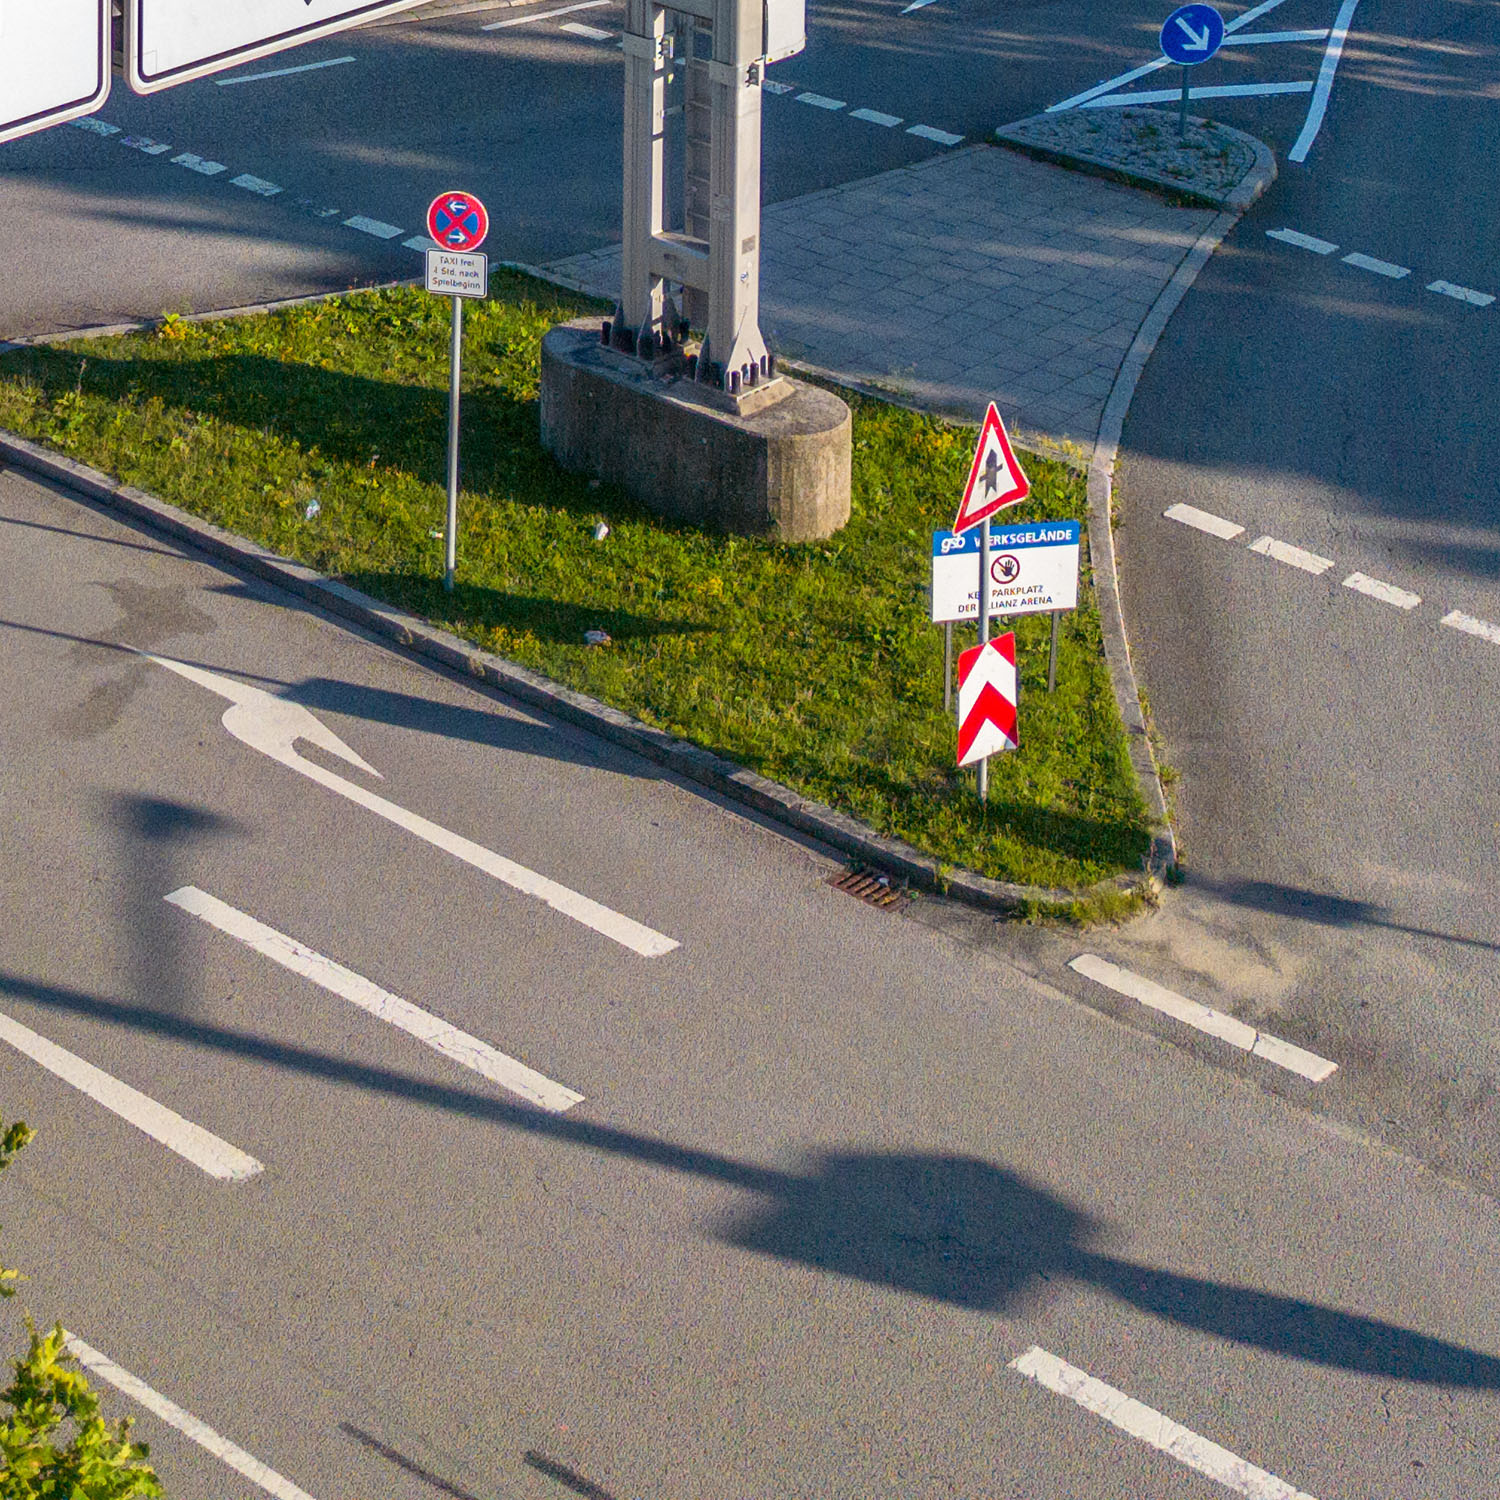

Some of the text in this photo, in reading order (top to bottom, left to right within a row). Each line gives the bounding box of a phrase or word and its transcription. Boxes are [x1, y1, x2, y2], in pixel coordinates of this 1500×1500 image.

[941, 534, 966, 553] gsb
[992, 584, 1043, 597] PARKPLATZ
[958, 601, 976, 613] DER
[1020, 595, 1053, 607] ARENA
